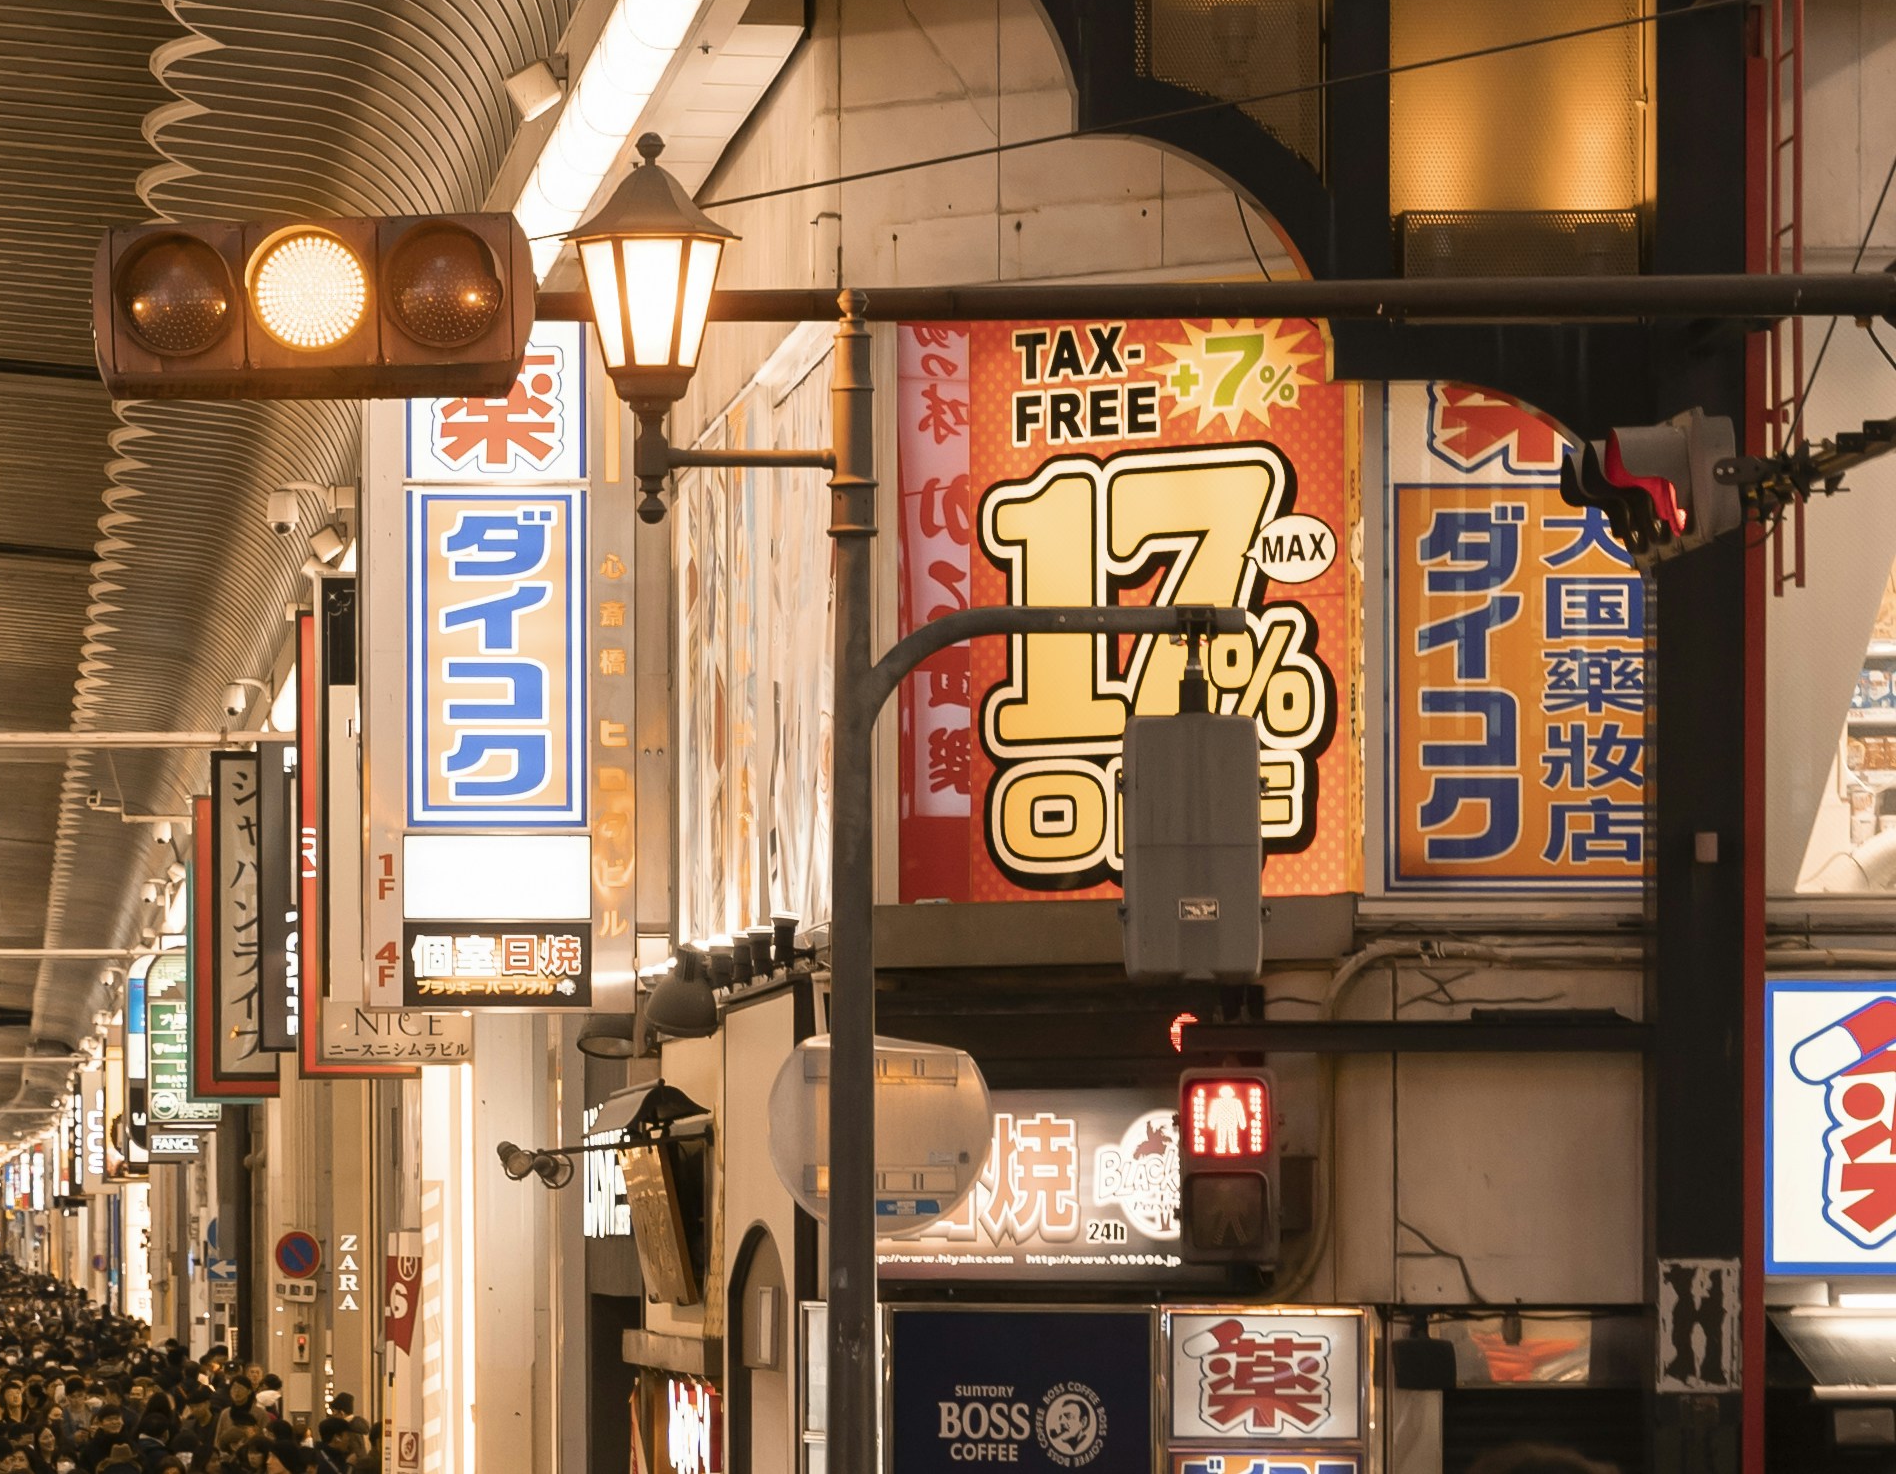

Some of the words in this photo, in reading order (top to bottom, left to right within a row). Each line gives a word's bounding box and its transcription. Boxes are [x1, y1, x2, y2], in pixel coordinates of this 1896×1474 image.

[1012, 324, 1144, 384] TAX-
[1169, 333, 1295, 407] +7%
[1012, 386, 1159, 447] FREE
[1261, 532, 1328, 566] MAX
[986, 451, 1320, 753] 17%
[442, 508, 555, 799] ダイコク
[1417, 503, 1526, 863] ダイコク
[378, 854, 395, 901] 1F
[375, 942, 400, 988] 4F
[411, 934, 581, 976] 個室日焼
[355, 1008, 444, 1037] NICE
[329, 1042, 470, 1058] ニースニシムラビル
[151, 1137, 198, 1151] FANCL
[1088, 1222, 1126, 1241] 24h
[338, 1234, 359, 1311] ZARA
[955, 1385, 1015, 1398] SUNTORY
[1067, 1381, 1100, 1406] COFFEE
[1205, 1335, 1325, 1430] 薬
[938, 1402, 1031, 1440] BOSS
[950, 1443, 1018, 1462] COFFEE
